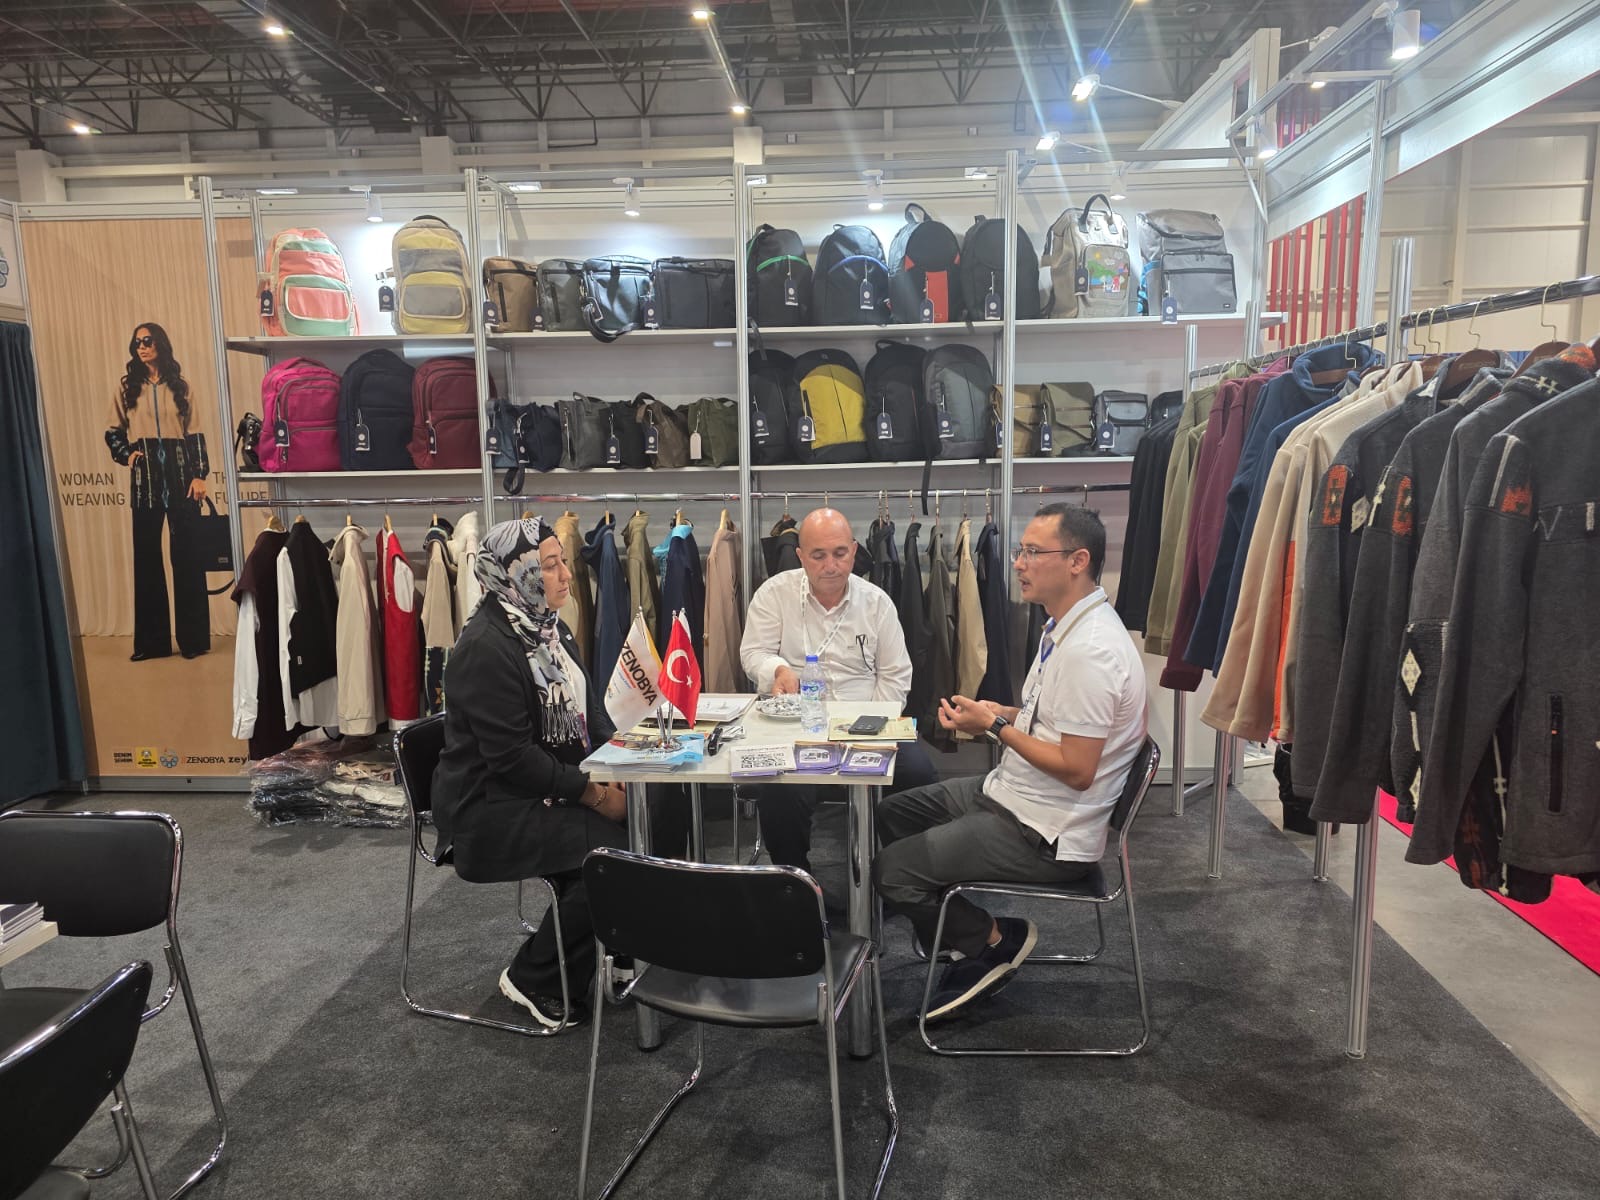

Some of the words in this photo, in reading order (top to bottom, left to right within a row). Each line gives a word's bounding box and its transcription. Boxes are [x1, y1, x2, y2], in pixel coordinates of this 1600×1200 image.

[60, 472, 114, 486] WOMAN
[62, 492, 125, 506] WEAVING
[186, 756, 226, 764] ZENOBYA
